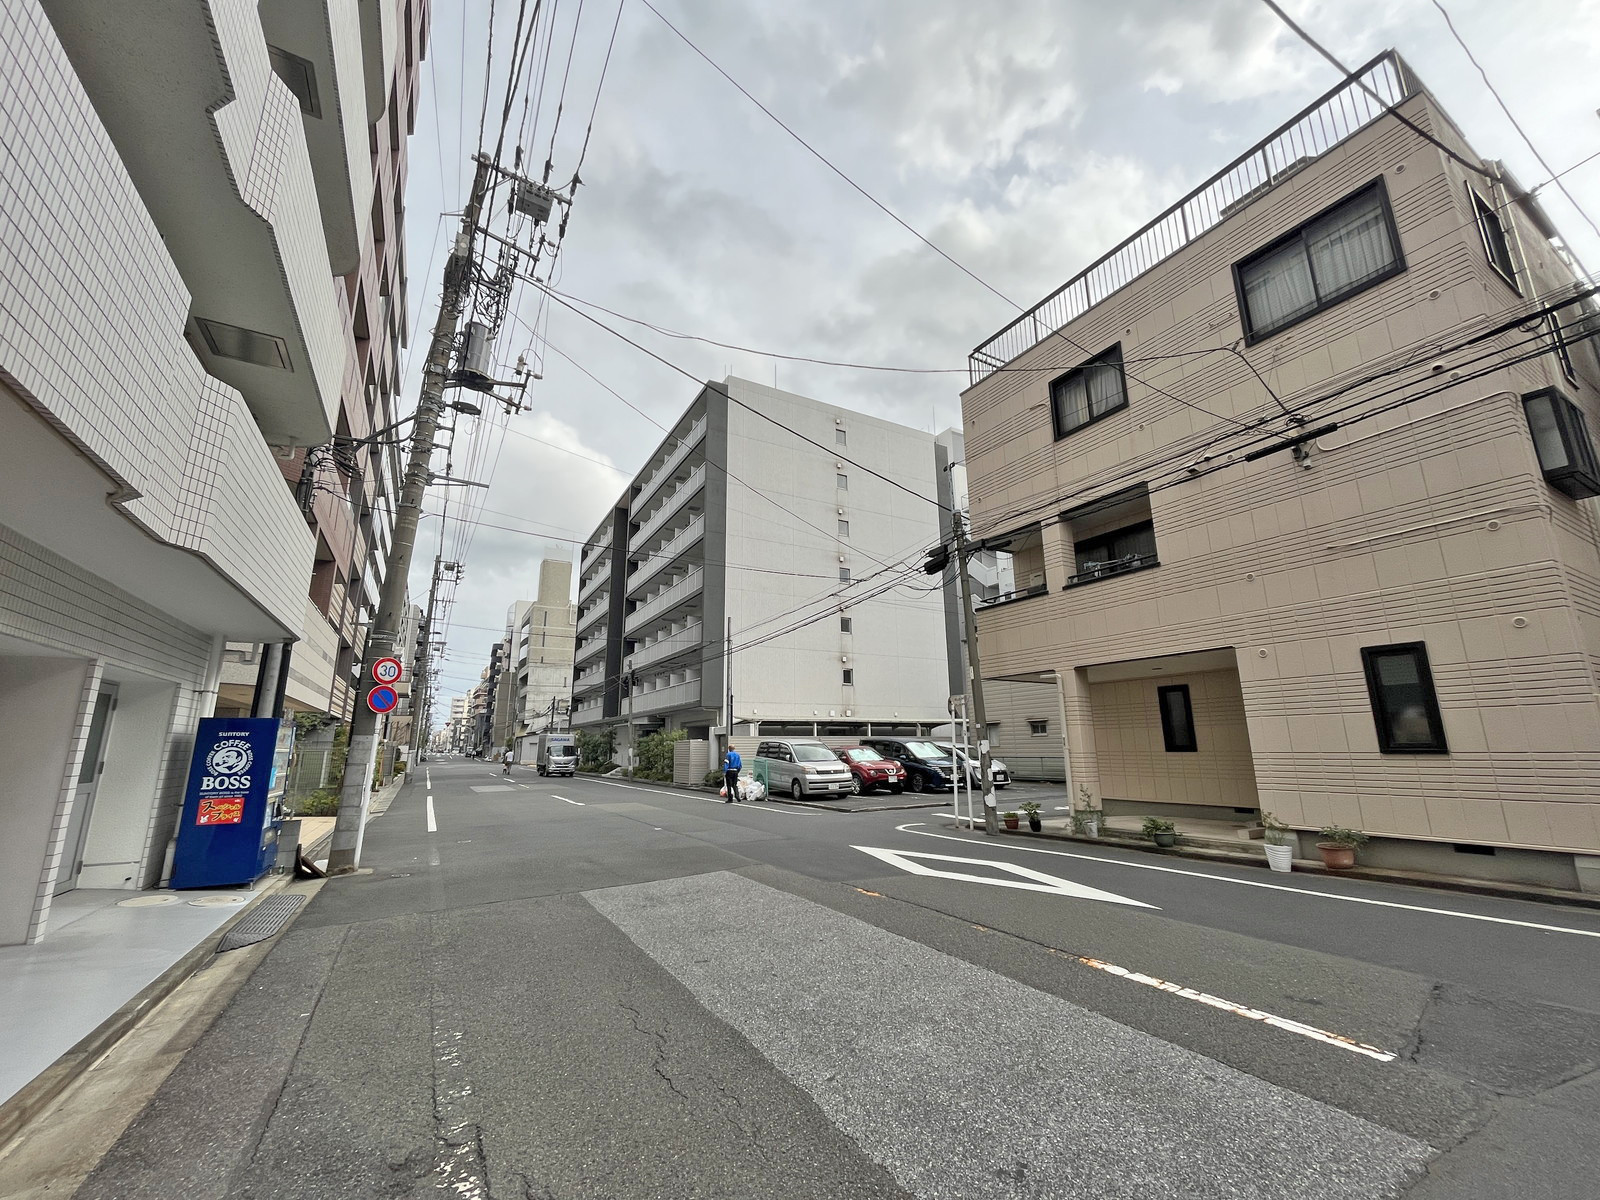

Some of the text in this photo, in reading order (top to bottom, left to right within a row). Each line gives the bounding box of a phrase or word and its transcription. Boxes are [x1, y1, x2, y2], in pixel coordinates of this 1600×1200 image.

[380, 665, 396, 677] 30
[213, 740, 252, 751] COFFEE
[200, 775, 251, 790] BOSS
